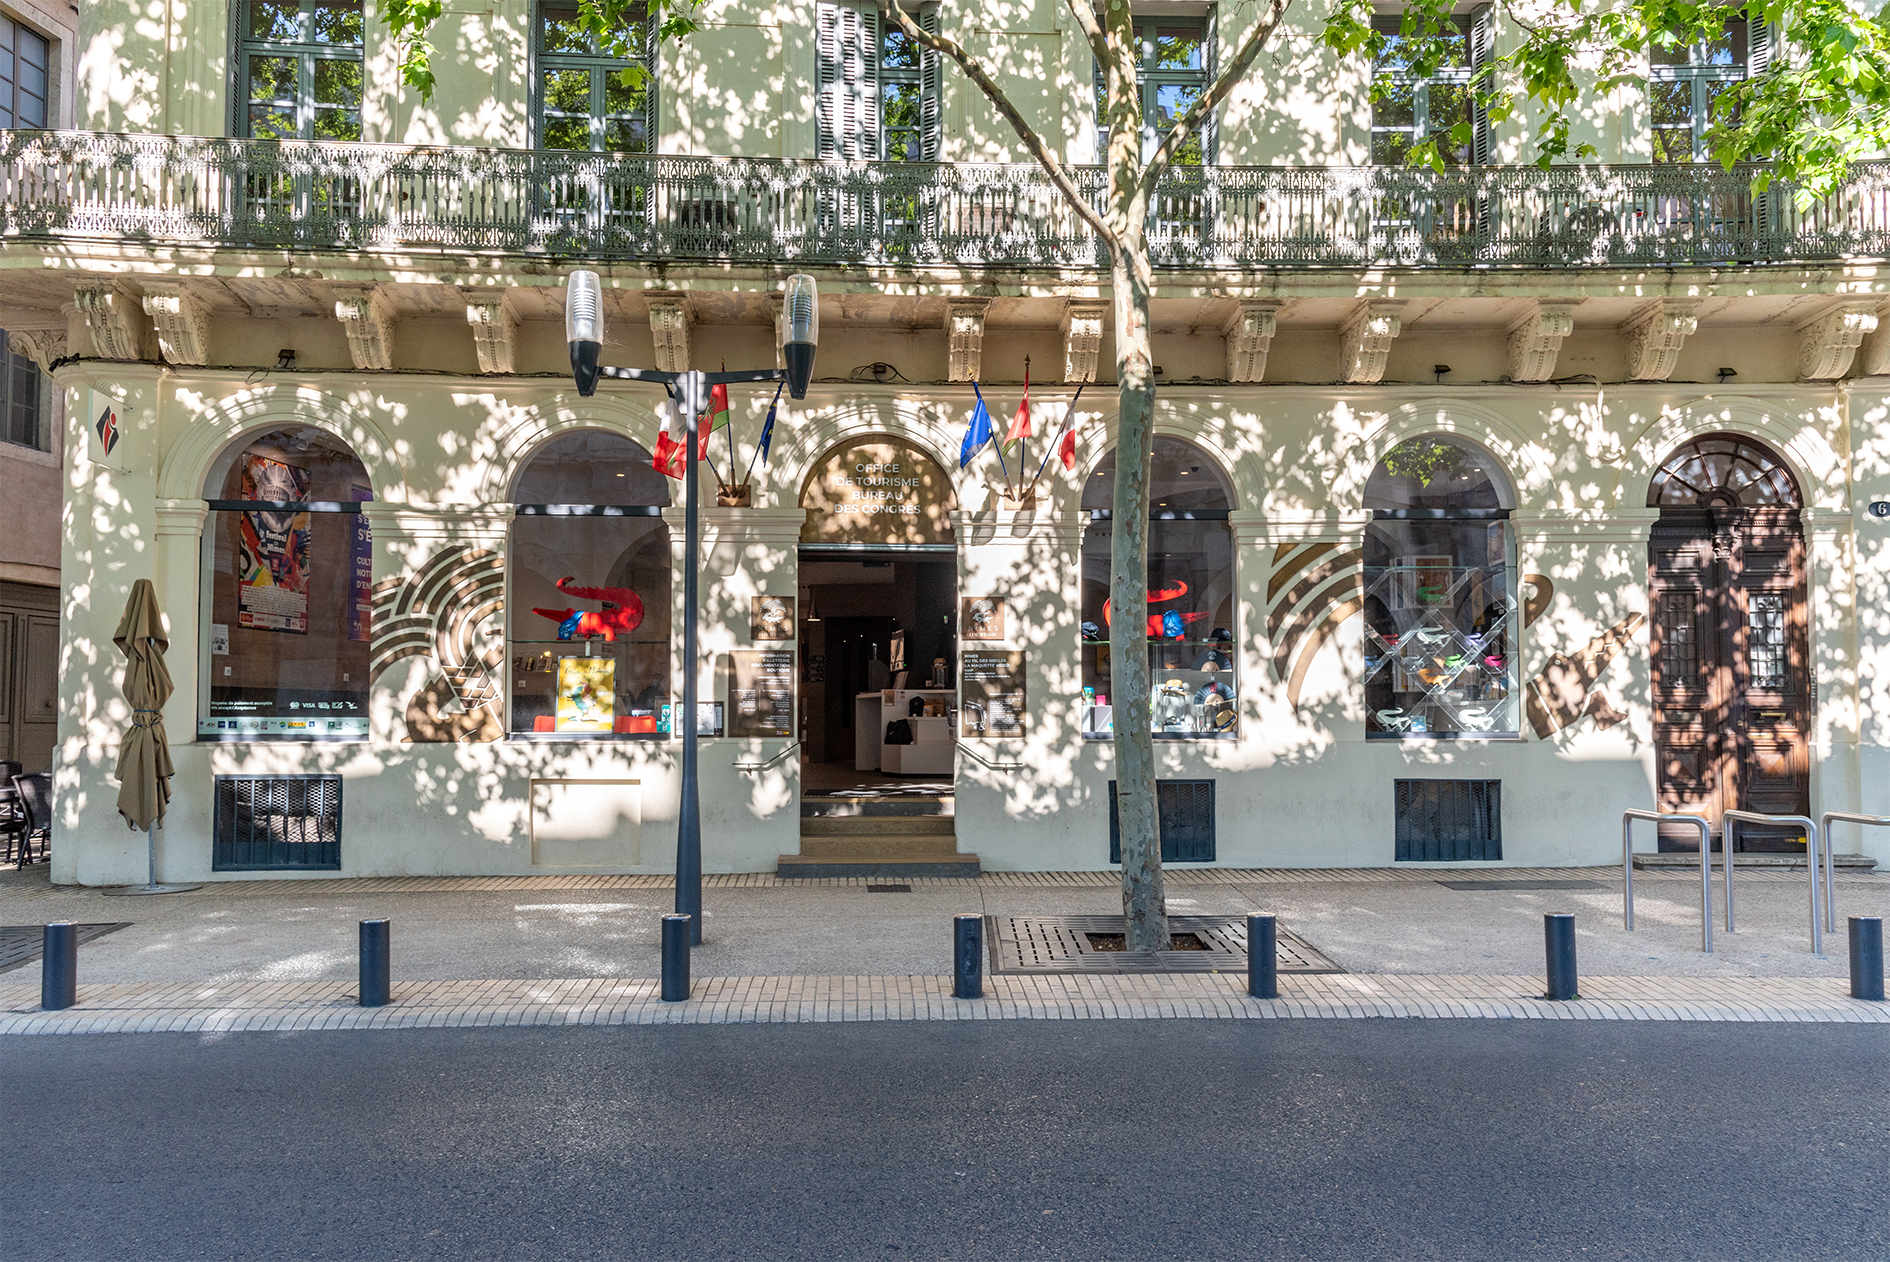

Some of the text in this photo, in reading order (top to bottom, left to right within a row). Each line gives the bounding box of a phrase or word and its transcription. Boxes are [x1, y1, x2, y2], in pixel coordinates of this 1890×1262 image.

[855, 463, 900, 473] OFFICE
[836, 477, 919, 487] DE TOURISME
[852, 490, 904, 500] BUREAU
[834, 502, 921, 514] DES CONGRÈS
[1877, 503, 1887, 514] 6
[265, 530, 287, 542] festival
